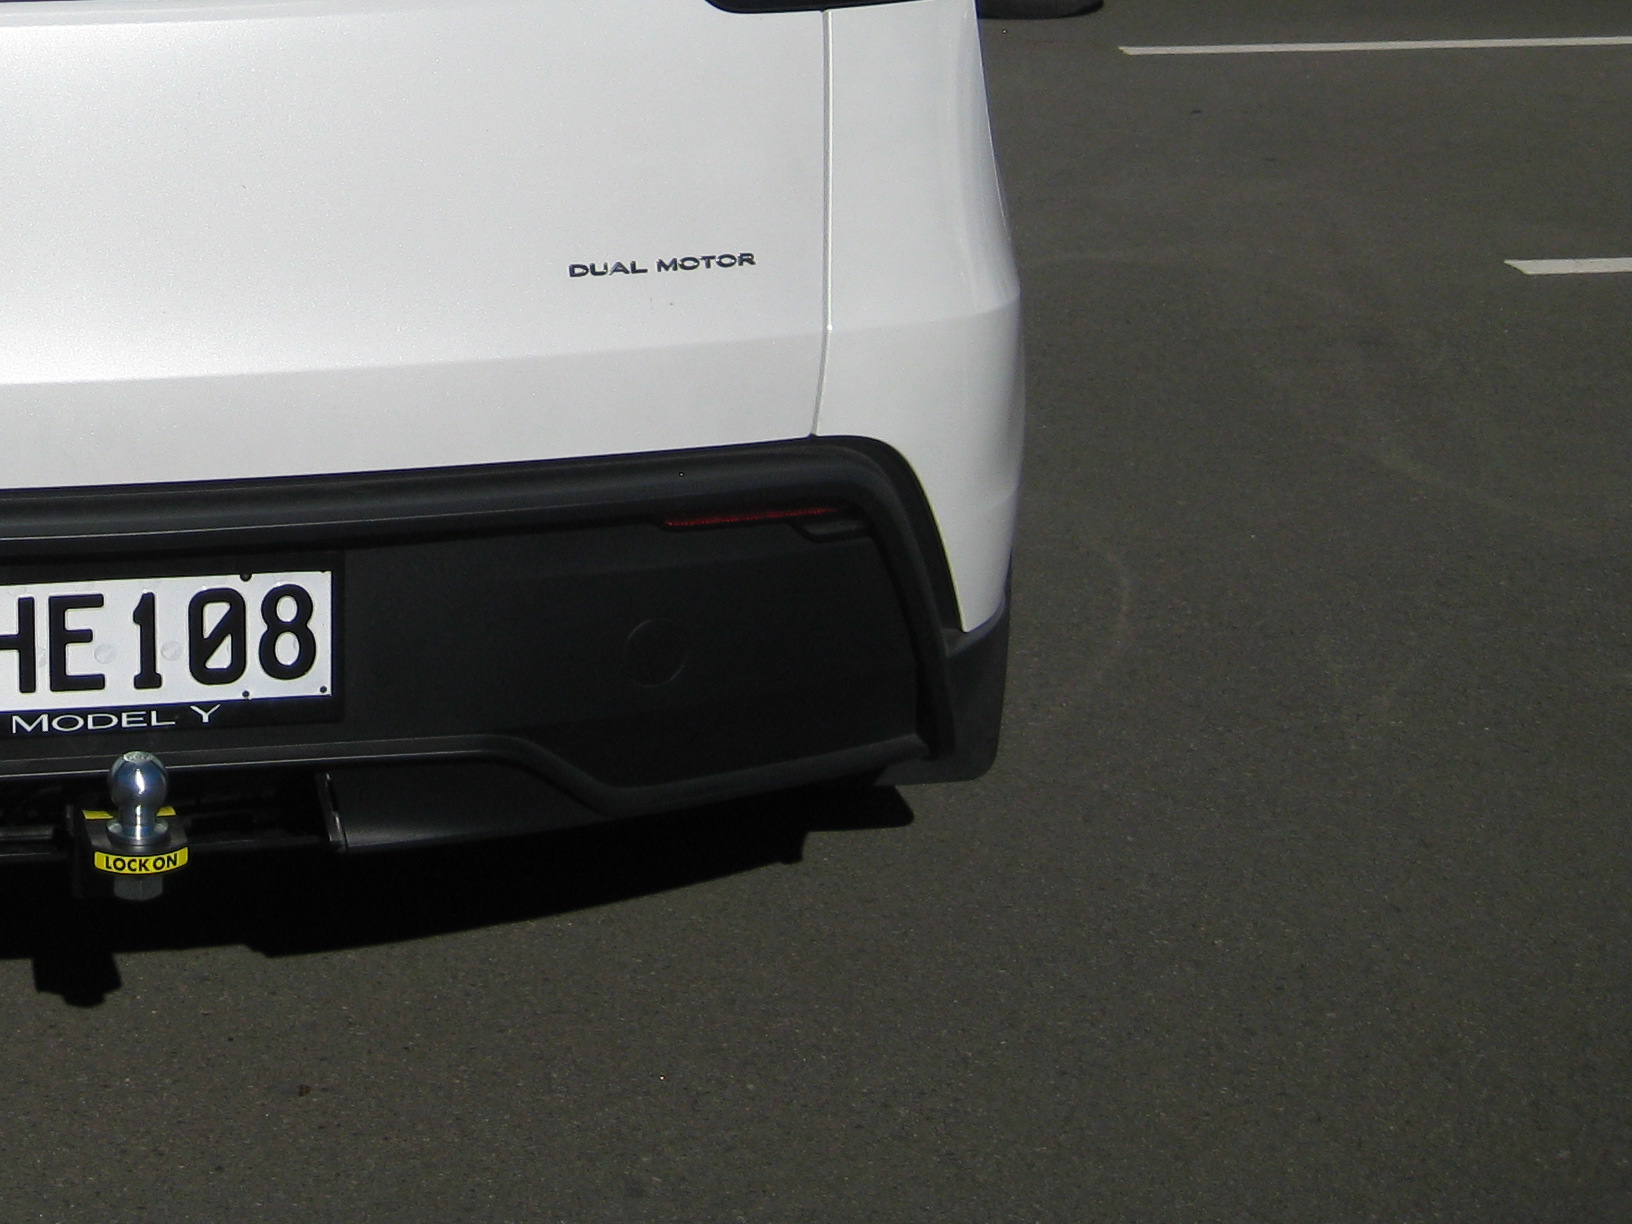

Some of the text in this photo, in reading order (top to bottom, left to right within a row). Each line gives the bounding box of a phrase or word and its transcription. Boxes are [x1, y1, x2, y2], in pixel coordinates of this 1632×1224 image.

[569, 252, 756, 278] DUAL MOTOR
[10, 703, 222, 734] MODEL Y
[105, 851, 178, 872] LOCK ON
